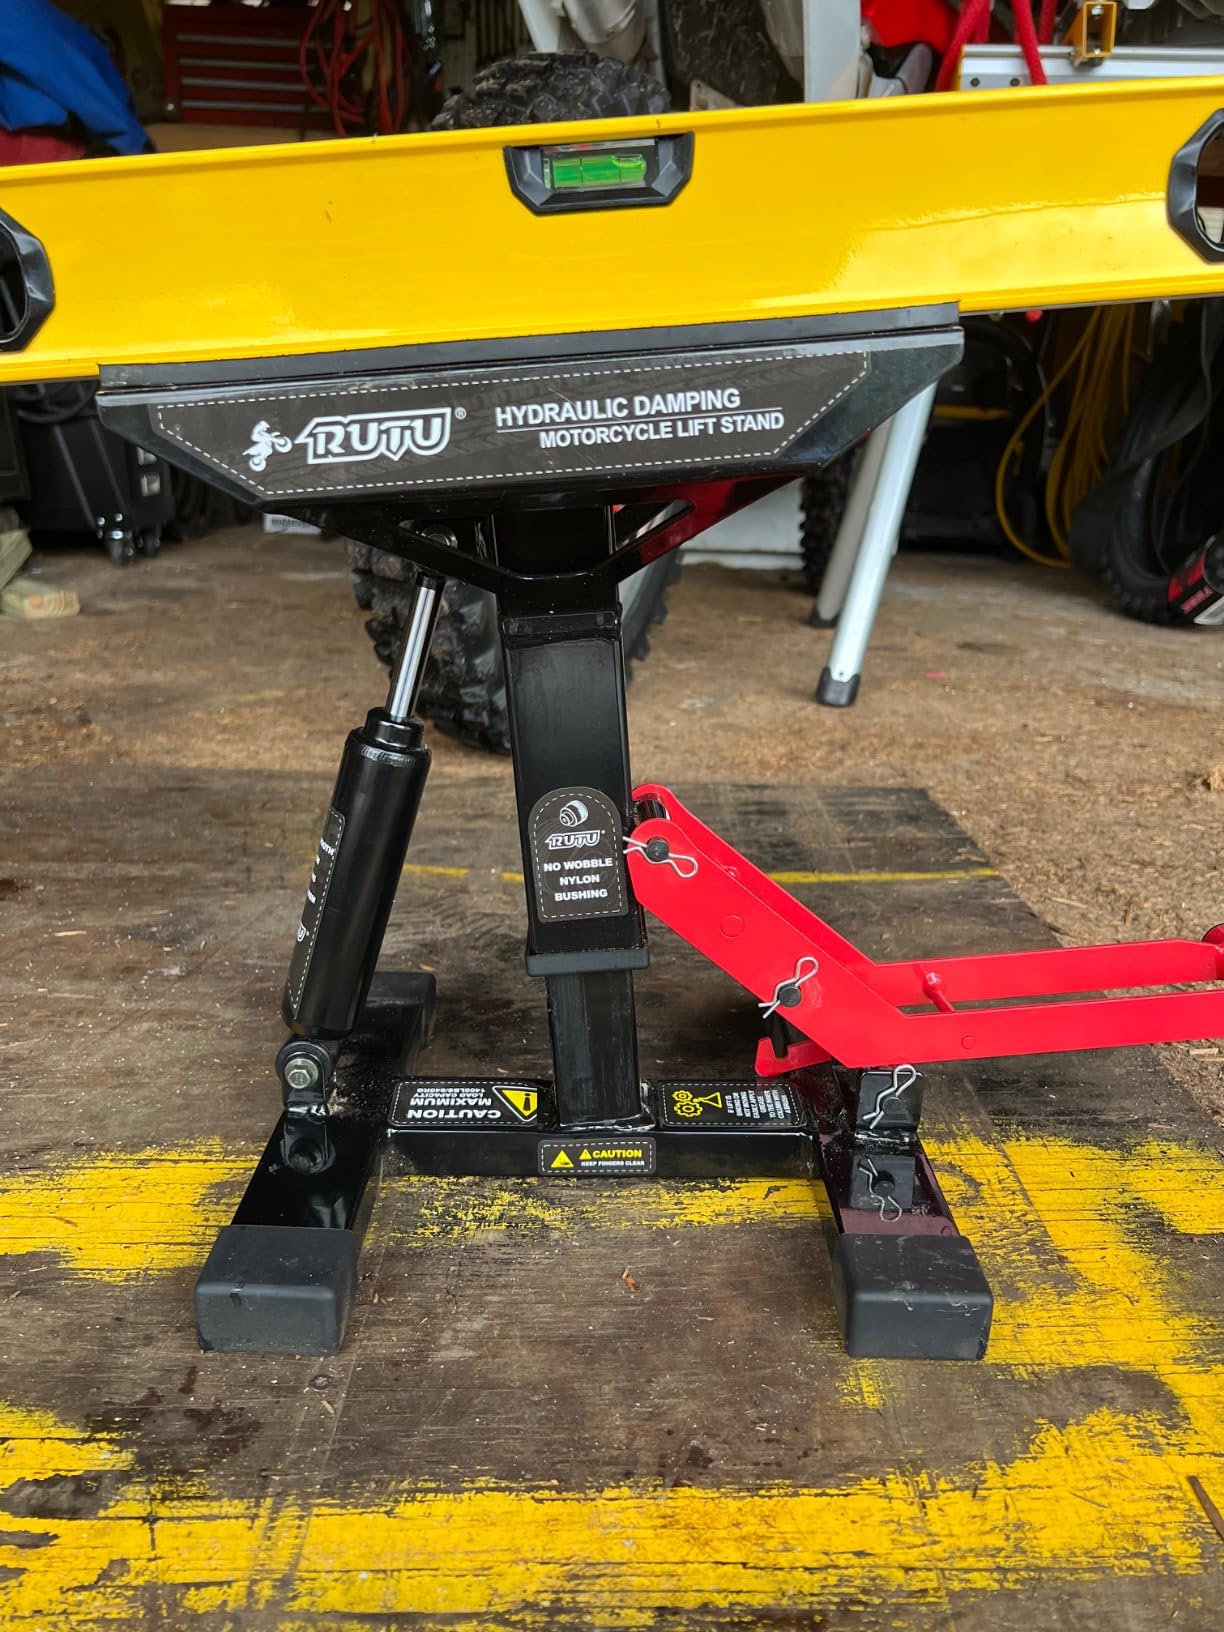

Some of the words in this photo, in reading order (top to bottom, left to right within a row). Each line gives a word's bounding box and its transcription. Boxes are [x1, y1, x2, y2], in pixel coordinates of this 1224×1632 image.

[495, 398, 628, 427] HYDRAULIC
[634, 388, 741, 416] DAMPING
[540, 422, 673, 448] MOTORCYCLE
[677, 418, 717, 437] LIFT
[720, 412, 785, 433] STAND
[544, 862, 561, 872] NO
[564, 858, 613, 870] WOBBLE
[560, 874, 600, 886] NYLON
[555, 889, 608, 901] BUSHING
[410, 1098, 492, 1106] MAXIMUM
[726, 1100, 734, 1109] LIFT
[766, 1103, 774, 1112] THE
[407, 1109, 501, 1119] CAUTION
[592, 1149, 642, 1158] CAUTION
